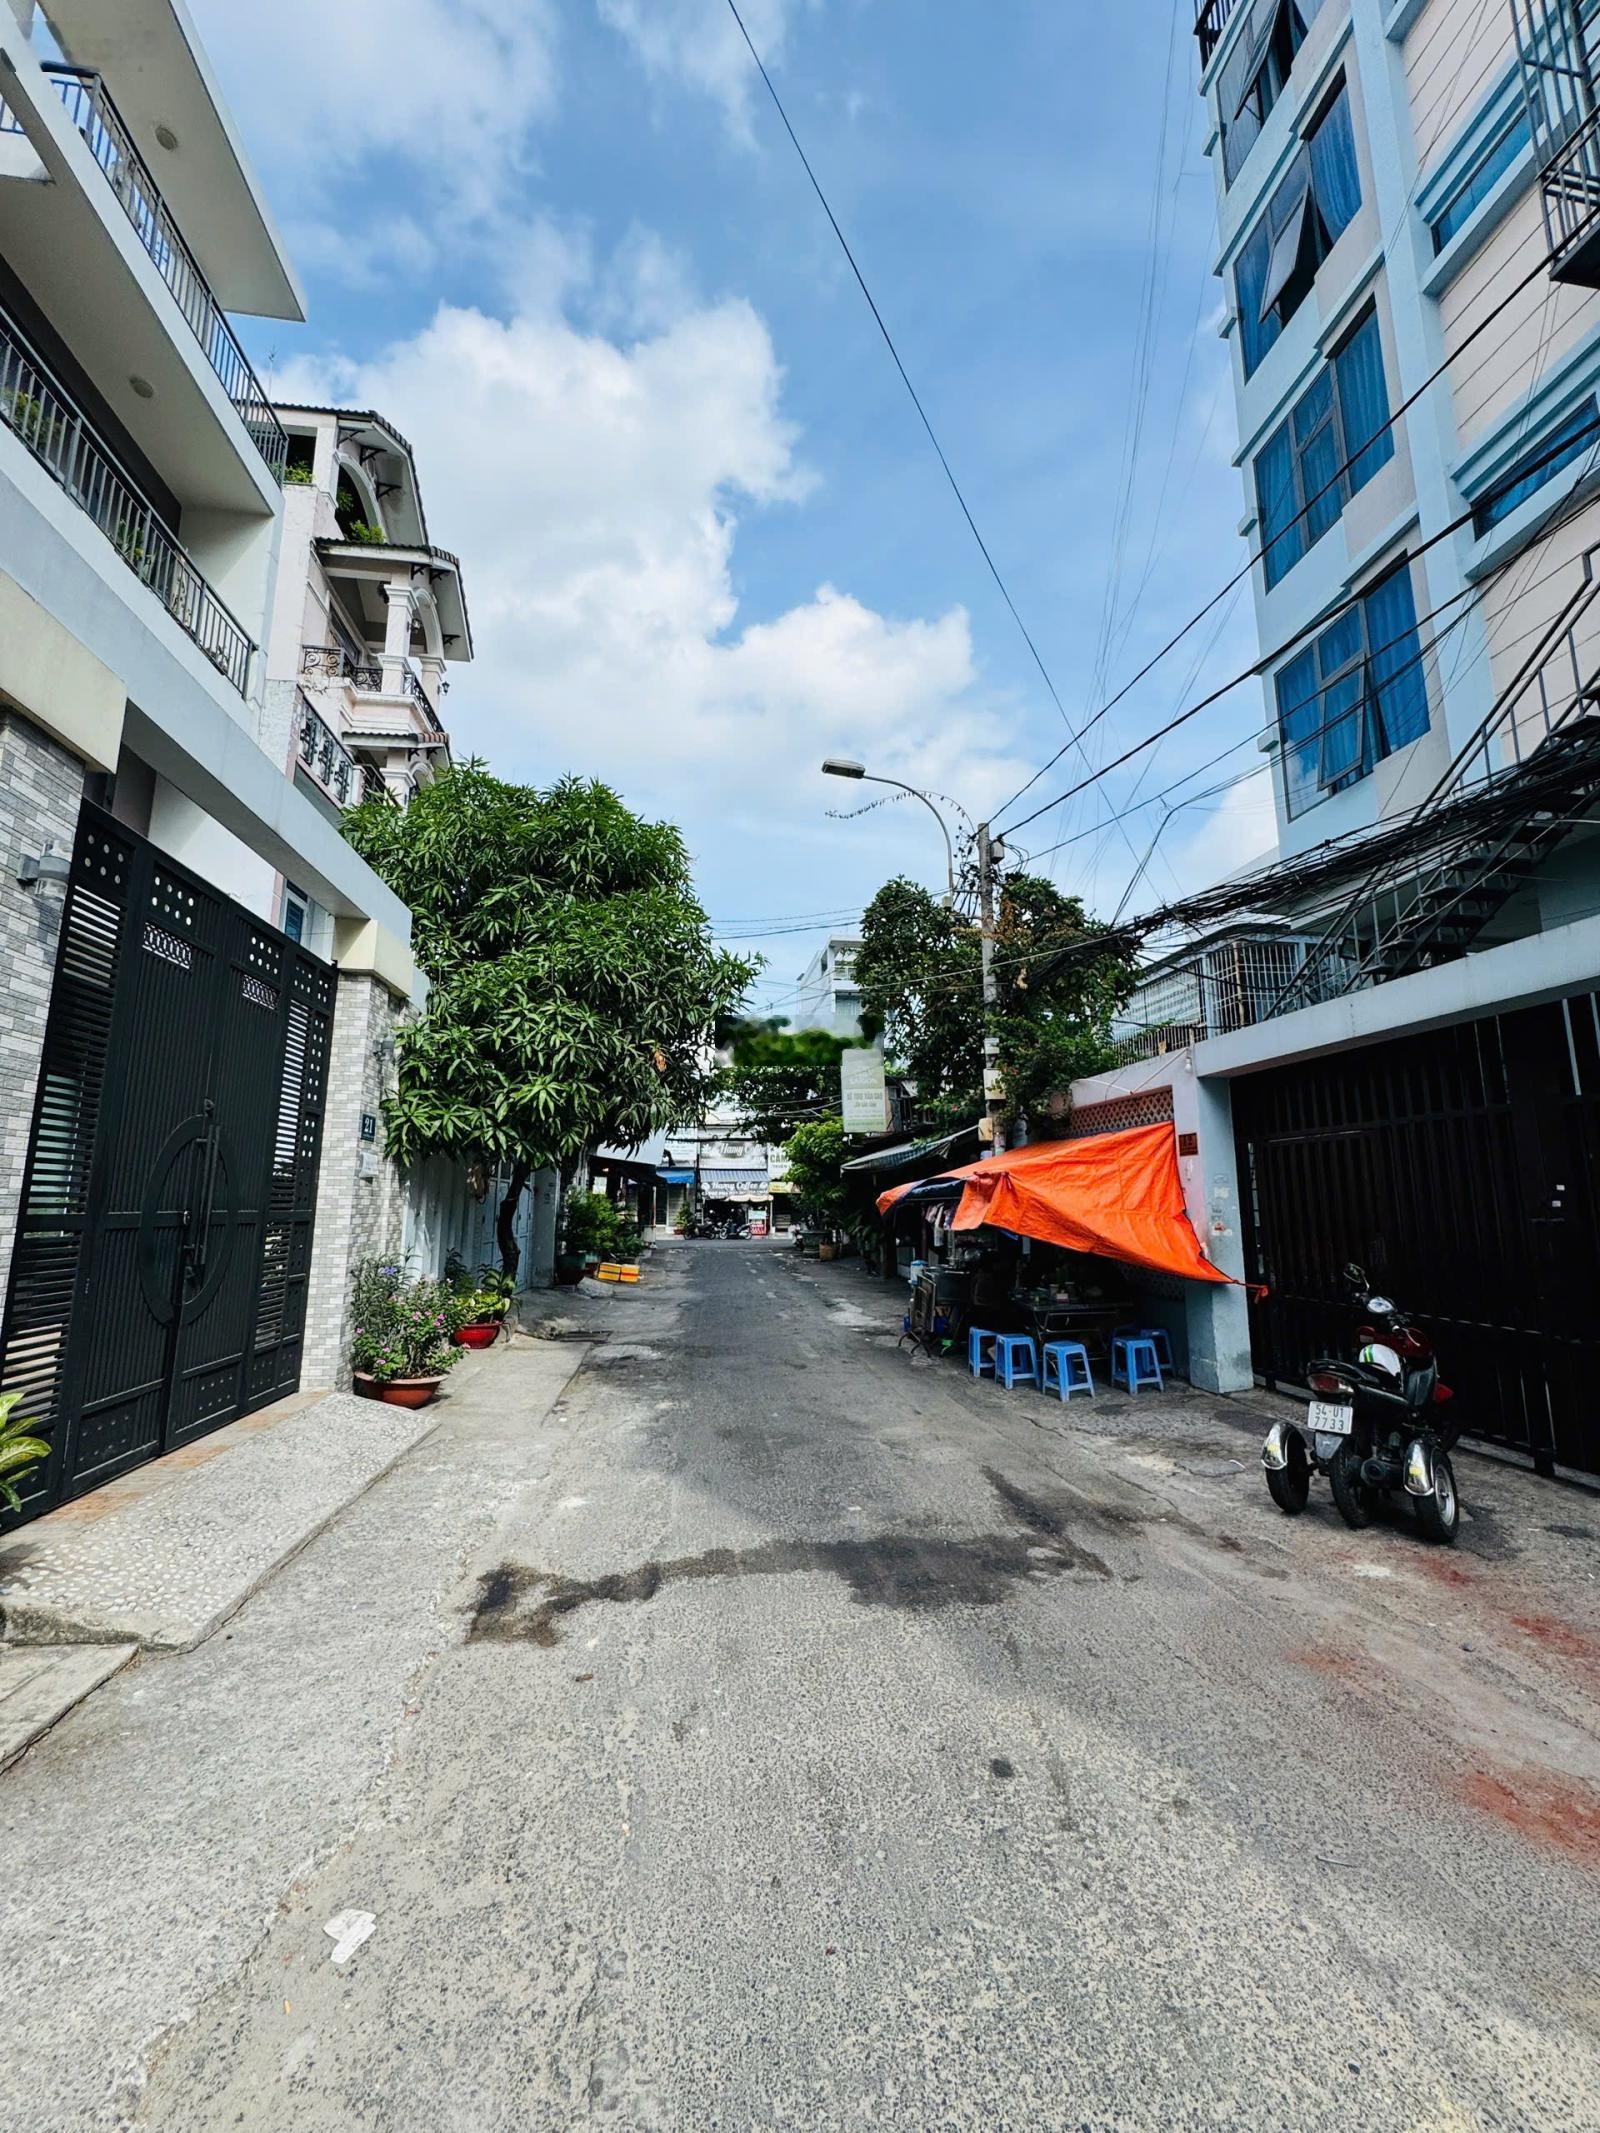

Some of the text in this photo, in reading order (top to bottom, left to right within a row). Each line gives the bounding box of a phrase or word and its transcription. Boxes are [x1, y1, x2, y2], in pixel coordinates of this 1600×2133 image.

[364, 1117, 373, 1133] 21
[720, 1142, 744, 1156] Hamy
[711, 1181, 759, 1191] Hamy Coffee
[1314, 1416, 1344, 1432] 7733
